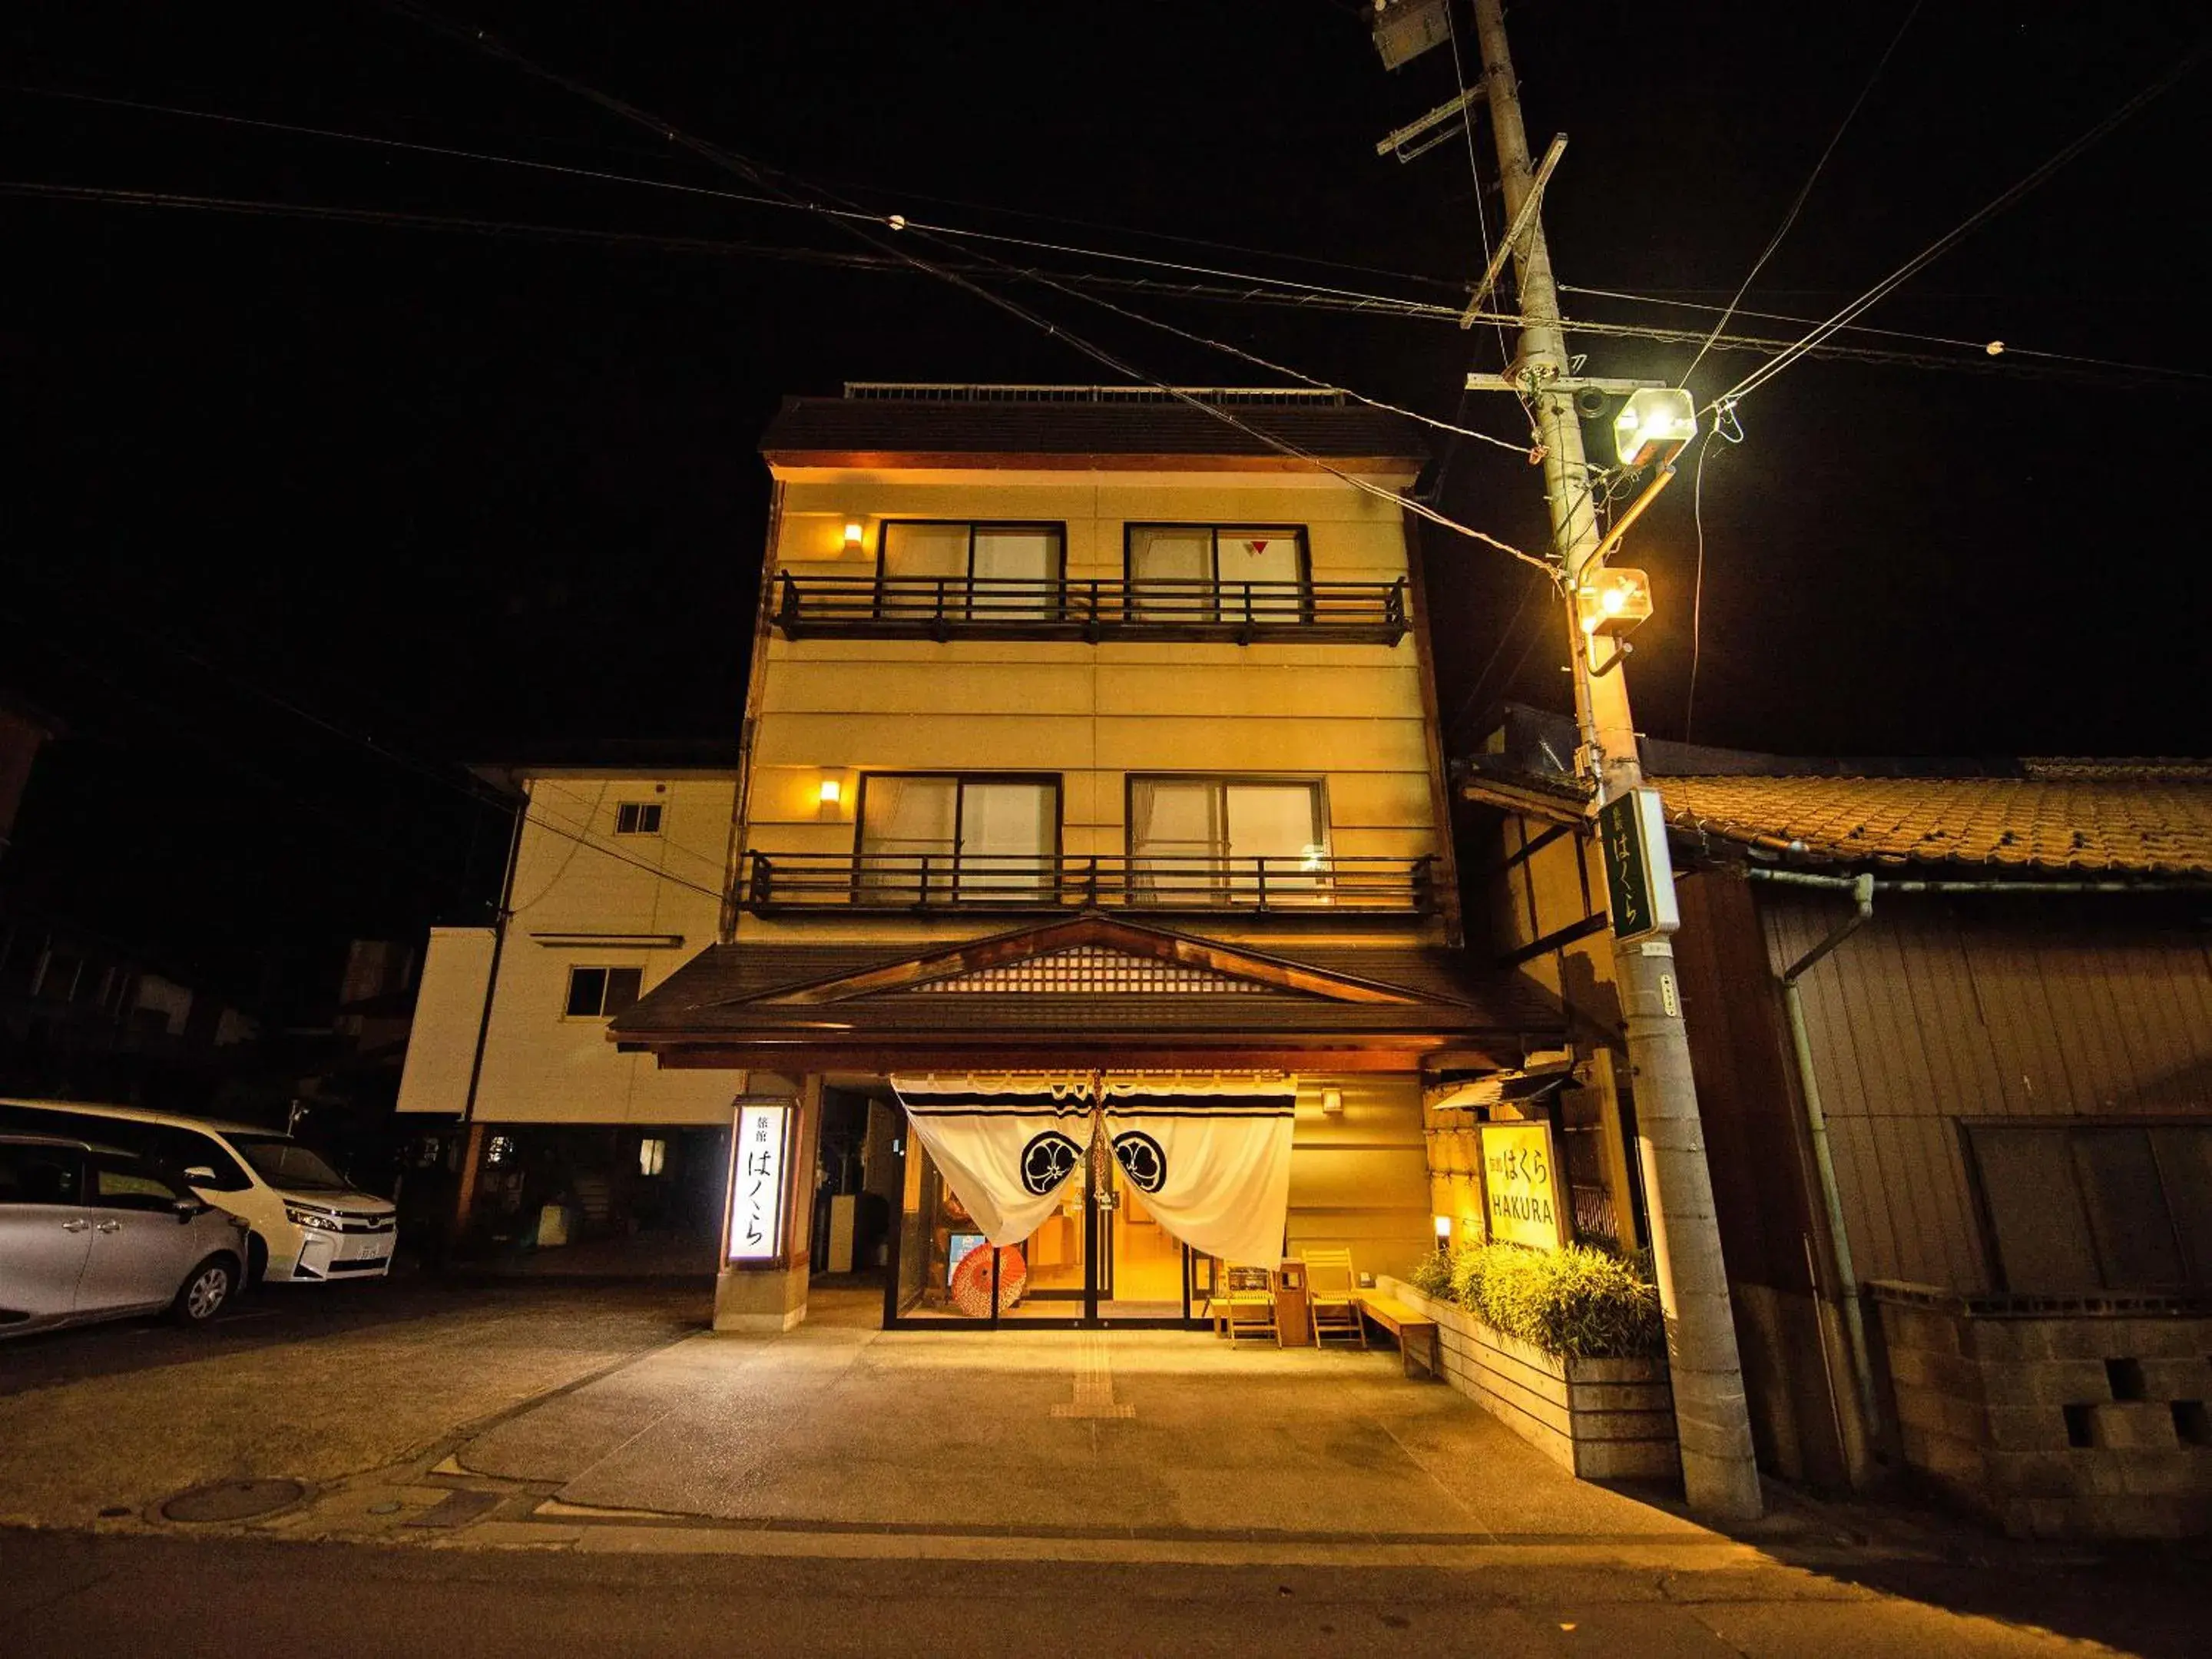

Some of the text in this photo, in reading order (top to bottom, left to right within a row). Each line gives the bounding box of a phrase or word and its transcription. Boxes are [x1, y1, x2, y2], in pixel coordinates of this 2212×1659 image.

[1613, 835, 1638, 926] はくら
[1503, 1147, 1547, 1184] はくら
[746, 1150, 771, 1247] はくら
[1492, 1193, 1554, 1226] HAKURA
